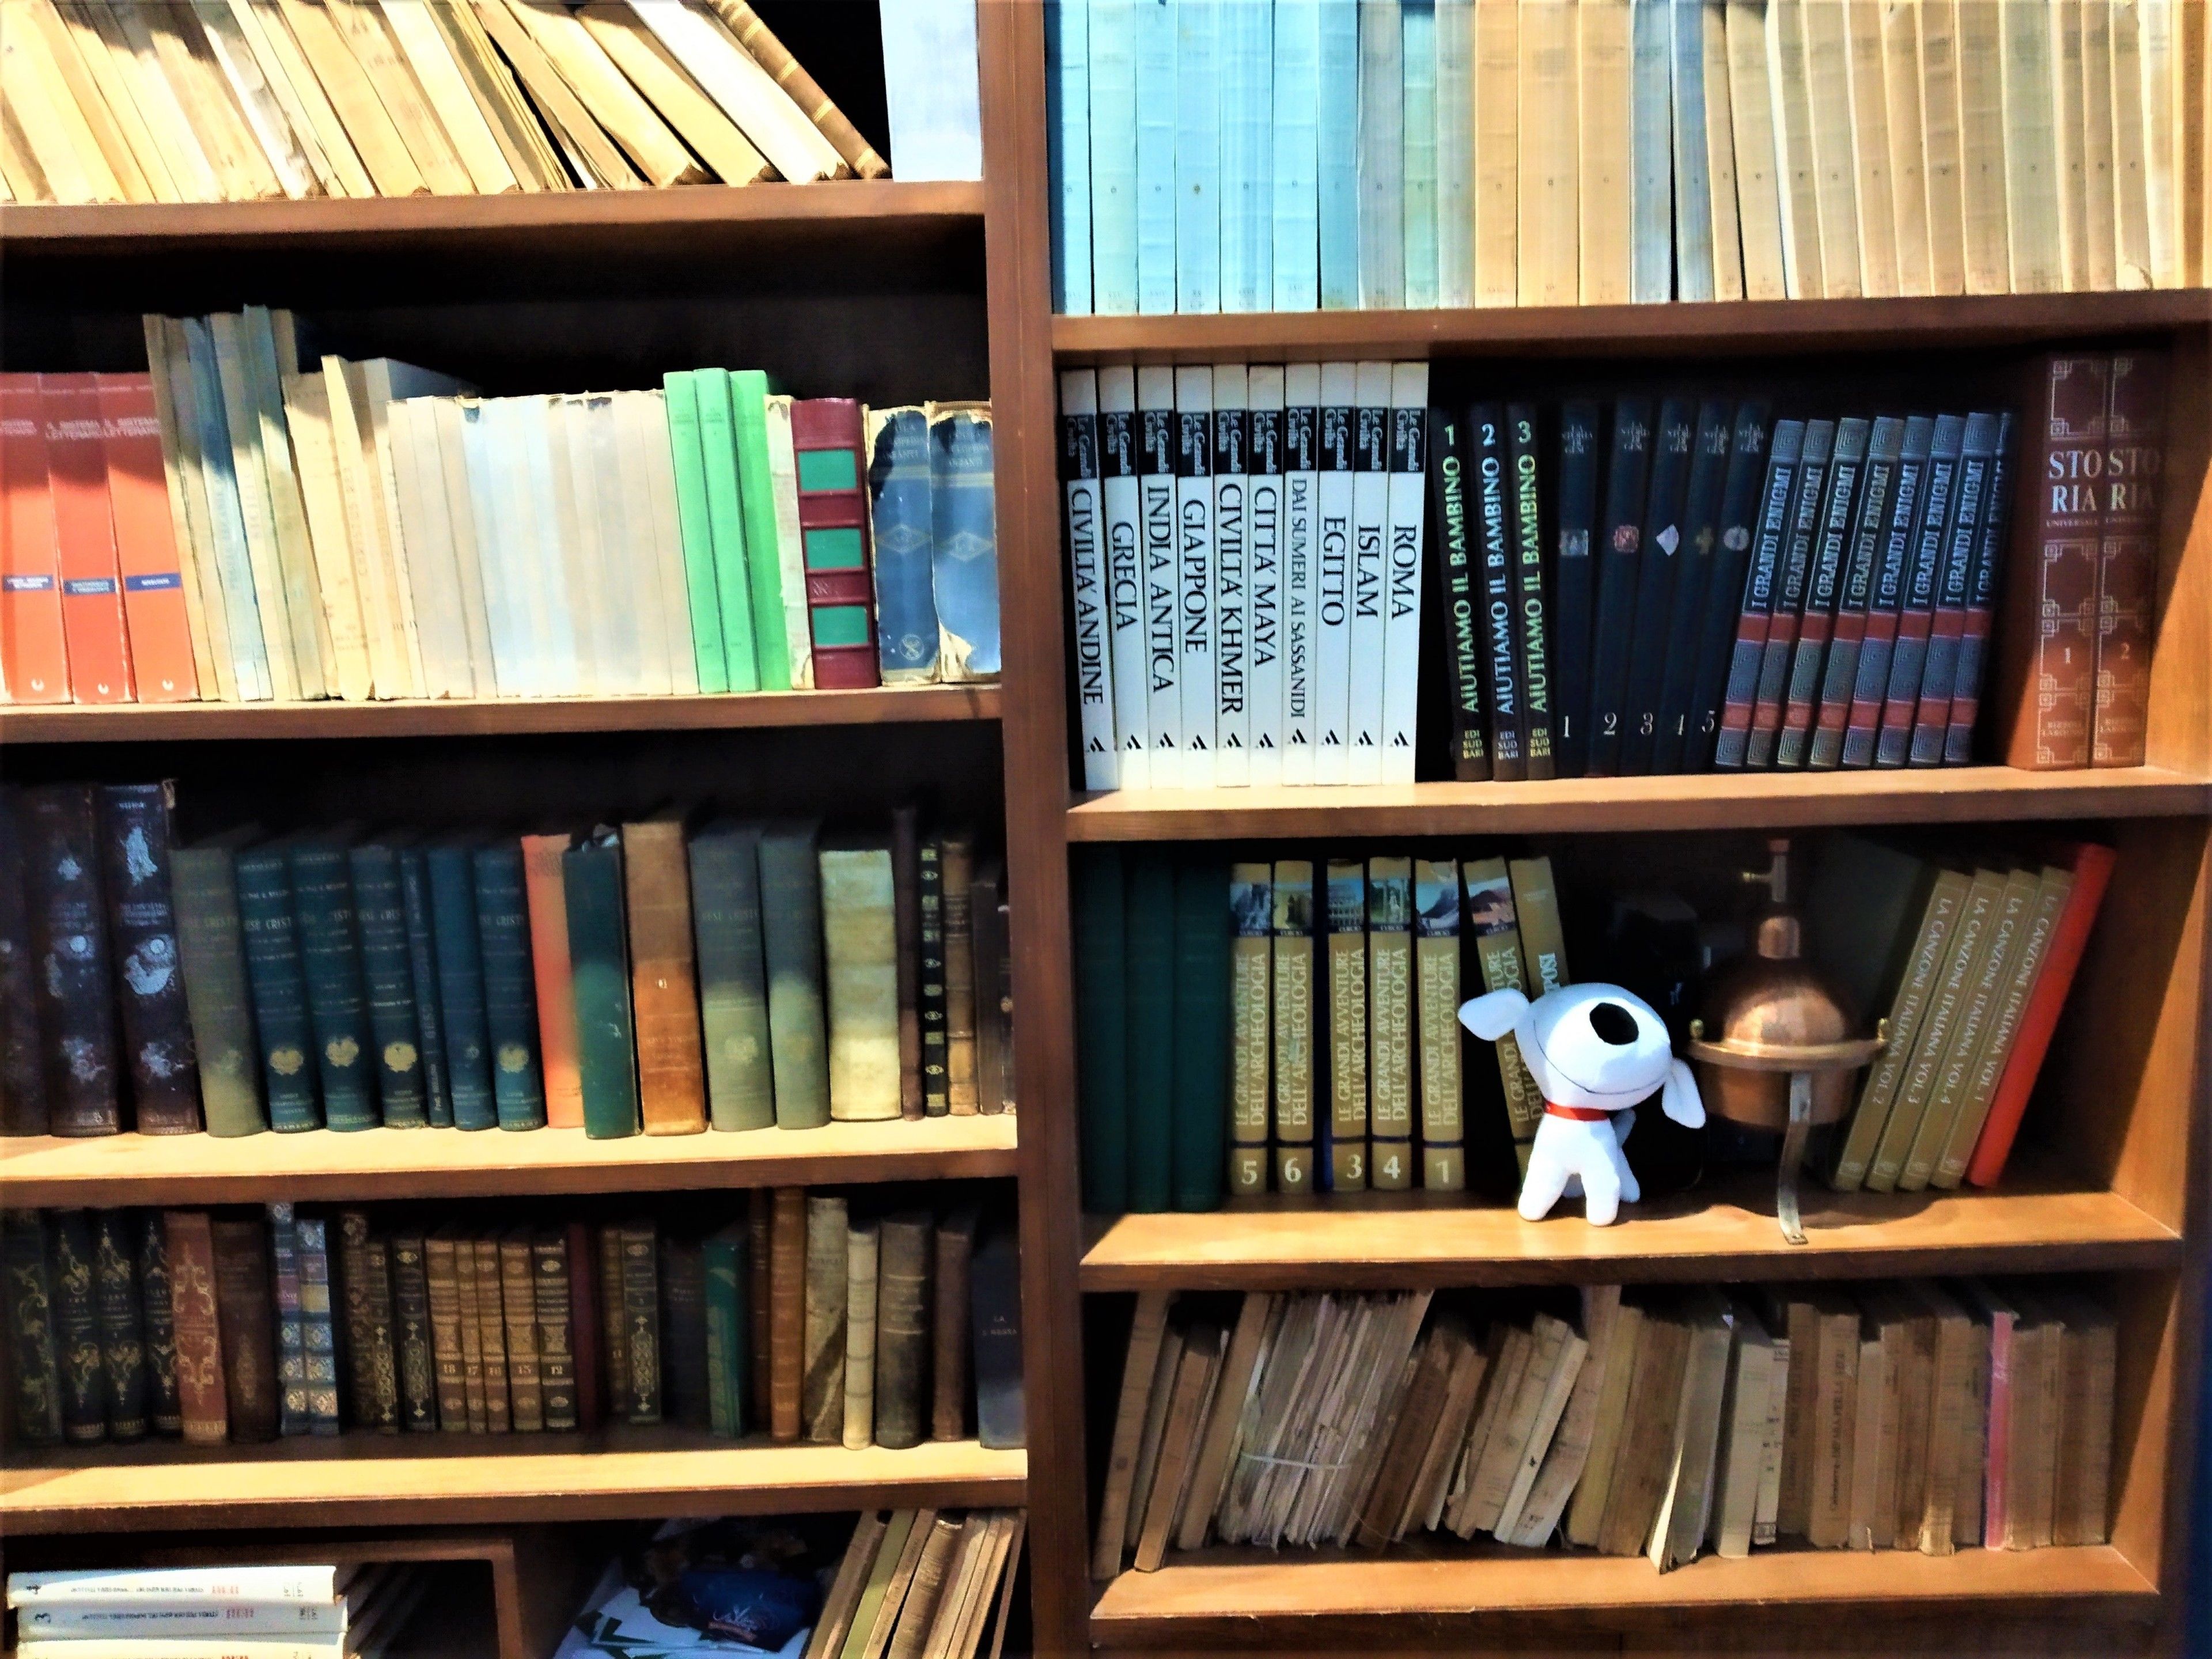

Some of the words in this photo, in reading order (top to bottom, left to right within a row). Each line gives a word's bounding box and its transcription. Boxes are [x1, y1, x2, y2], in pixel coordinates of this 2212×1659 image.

[1078, 416, 1088, 431] Le
[1118, 414, 1129, 431] Le
[1157, 411, 1168, 430] Le
[1194, 415, 1204, 431] Le
[1230, 411, 1241, 428] Le
[1266, 412, 1277, 429] Le
[1301, 410, 1311, 425] Le
[1338, 410, 1349, 425] Le
[1372, 410, 1383, 425] Le
[1410, 410, 1421, 425] Le
[1444, 424, 1455, 446] 1
[1482, 423, 1495, 446] 2
[1518, 421, 1531, 444] 3
[1078, 434, 1092, 479] Grandi
[1119, 431, 1131, 475] Grandi
[1157, 429, 1169, 474] Grandi
[1194, 431, 1205, 476] Grandi
[1230, 429, 1241, 474] Grandi
[1266, 429, 1277, 474] Grandi
[1300, 426, 1311, 470] Grandi
[1336, 426, 1348, 470] Grandi
[1372, 426, 1382, 471] Grandi
[1408, 427, 1419, 471] Grandi
[2048, 449, 2103, 480] STO
[1292, 478, 1306, 511] DAI
[1442, 456, 1467, 566] BAMBINO
[1482, 457, 1504, 567] BAMBINO
[1518, 454, 1539, 565] BAMBINO
[1829, 465, 1855, 529] ENIGMI
[1863, 464, 1890, 529] ENIGMI
[1893, 463, 1919, 528] ENIGMI
[1959, 460, 1984, 525] ENIGMI
[2051, 483, 2098, 514] RIA
[1147, 487, 1171, 572] INDIA
[1753, 533, 1779, 598] GRANDI
[1766, 467, 1791, 531] ENIGMI
[1785, 533, 1810, 598] GRANDI
[1798, 466, 1823, 531] ENIGMI
[1914, 530, 1940, 594] GRANDI
[1927, 462, 1952, 527] ENIGMI
[1112, 521, 1138, 630] GRECIA
[1183, 499, 1207, 653] GIAPPONE
[1291, 518, 1306, 590] SUMERI
[1321, 516, 1346, 626] EGITTO
[1357, 524, 1380, 618] ISLAM
[1392, 524, 1416, 620] ROMA
[1817, 532, 1843, 597] GRANDI
[1851, 531, 1877, 597] GRANDI
[1881, 531, 1906, 596] GRANDI
[1948, 528, 1972, 592] GRANDI
[1452, 571, 1469, 593] IL
[1489, 573, 1506, 594] IL
[1524, 570, 1541, 591] IL
[1255, 583, 1276, 668] MAYA
[1291, 597, 1305, 615] AI
[1079, 600, 1103, 704] ANDINE
[1150, 582, 1174, 692] ANTICA
[1453, 600, 1479, 713] AIUTIAMO
[1491, 601, 1514, 715] AIUTIAMO
[1525, 598, 1547, 712] AIUTIAMO
[2065, 647, 2071, 664] 1
[2120, 642, 2130, 660] 2
[1221, 605, 1243, 715] KHMER
[1290, 623, 1305, 718] SASSANIDI
[1463, 738, 1482, 749] SUD
[1464, 730, 1480, 739] EDI
[1500, 730, 1514, 740] EDI
[1530, 737, 1550, 747] SUD
[1532, 728, 1547, 737] EDI
[1563, 715, 1570, 738] 1
[1604, 712, 1617, 735] 2
[1641, 712, 1653, 735] 3
[1702, 710, 1715, 733] 5
[1463, 749, 1484, 759] BARI
[1498, 740, 1517, 749] SUD
[1498, 750, 1518, 760] BARI
[1530, 747, 1551, 757] BARI
[1937, 897, 1952, 915] LA
[1974, 897, 1988, 915] LA
[2006, 897, 2022, 914] LA
[1912, 920, 1944, 989] CANZONE
[1948, 920, 1981, 989] CANZONE
[1981, 920, 2014, 989] CANZONE
[2016, 918, 2049, 986] CANZONE
[1236, 953, 1249, 1040] AVVENTURE
[1277, 953, 1290, 1039] AVVENTURE
[1336, 950, 1350, 1037] AVVENTURE
[1377, 949, 1391, 1035] AVVENTURE
[1425, 954, 1439, 1040] AVVENTURE
[1888, 995, 1919, 1057] ITALIANA
[1924, 993, 1955, 1056] ITALIANA
[1957, 993, 1987, 1056] ITALIANA
[1991, 991, 2021, 1054] ITALIANA
[1236, 1046, 1249, 1105] GRANDI
[1277, 1046, 1290, 1104] GRANDI
[1337, 1041, 1351, 1101] GRANDI
[1377, 1040, 1391, 1100] GRANDI
[1427, 1046, 1440, 1105] GRANDI
[1504, 1043, 1525, 1101] GRANDI
[1241, 1160, 1257, 1185] 5
[1285, 1157, 1302, 1183] 6
[1347, 1154, 1362, 1180] 3
[1383, 1155, 1401, 1180] 4
[1435, 1160, 1449, 1184] 1
